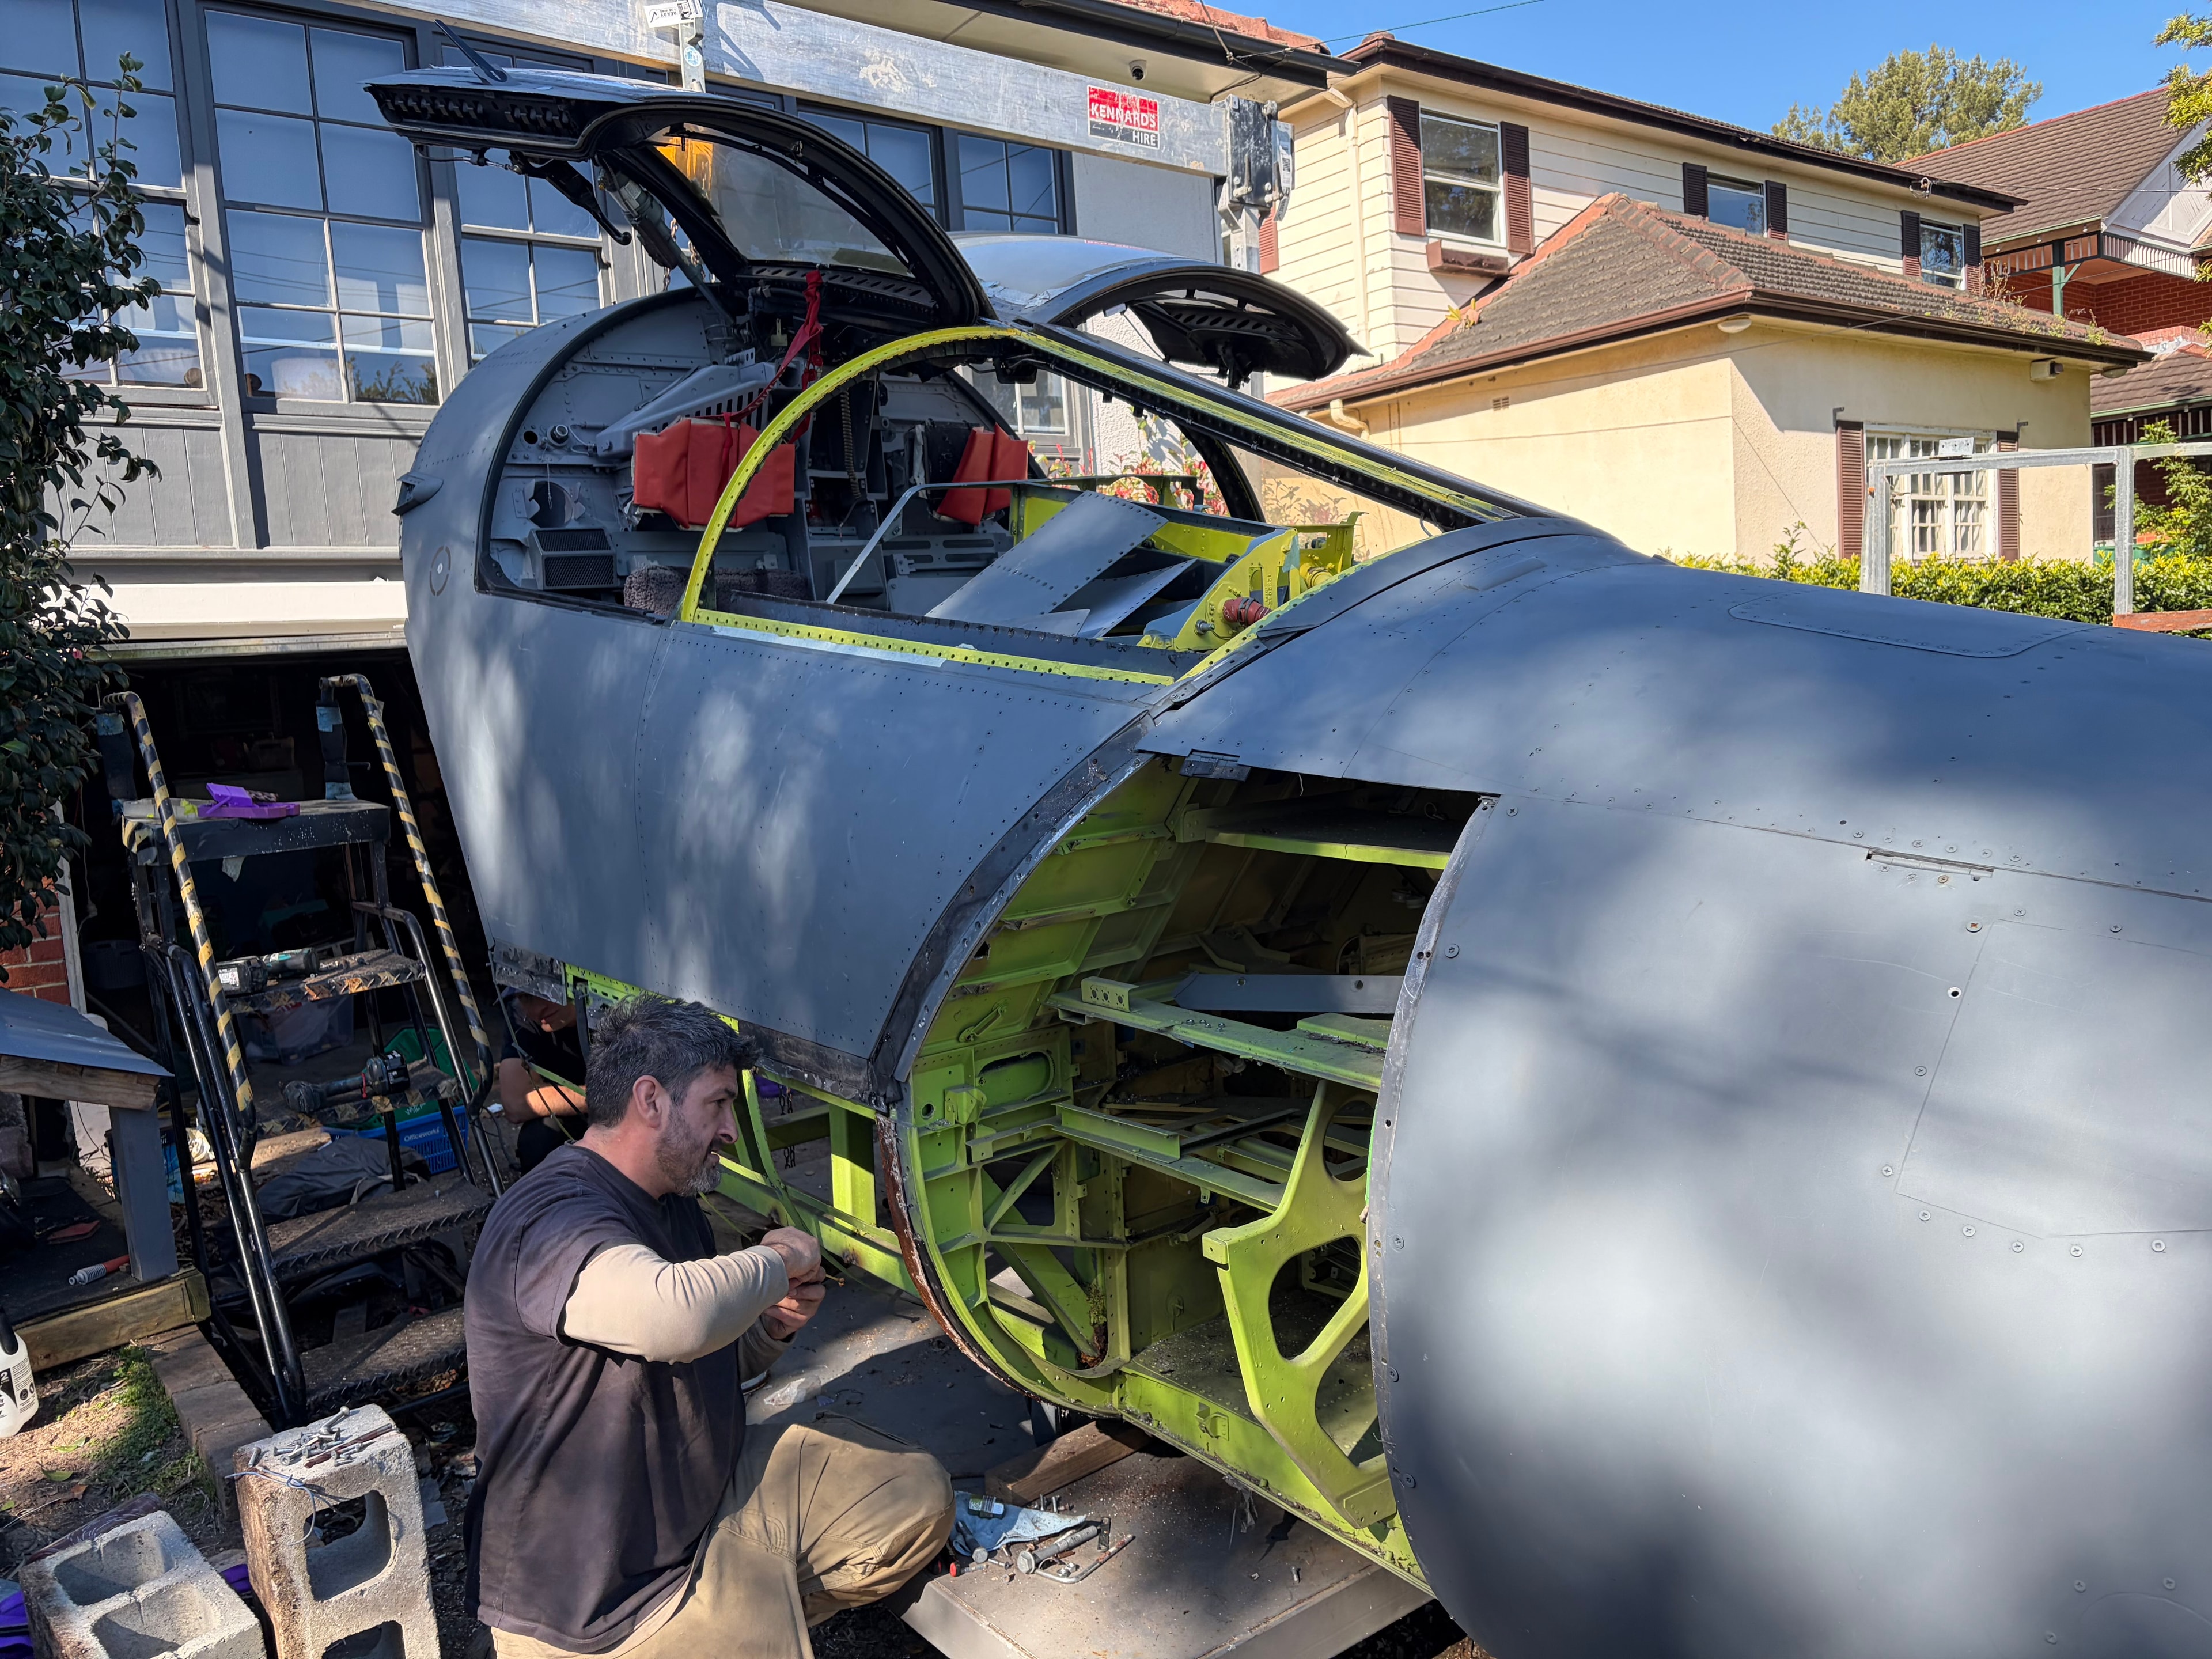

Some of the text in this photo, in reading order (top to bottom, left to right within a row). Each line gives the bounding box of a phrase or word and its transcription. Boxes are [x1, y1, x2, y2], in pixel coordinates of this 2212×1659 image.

[1090, 102, 1156, 128] KENNARDS
[1132, 130, 1156, 146] HIRE
[1, 1372, 9, 1381] 2
